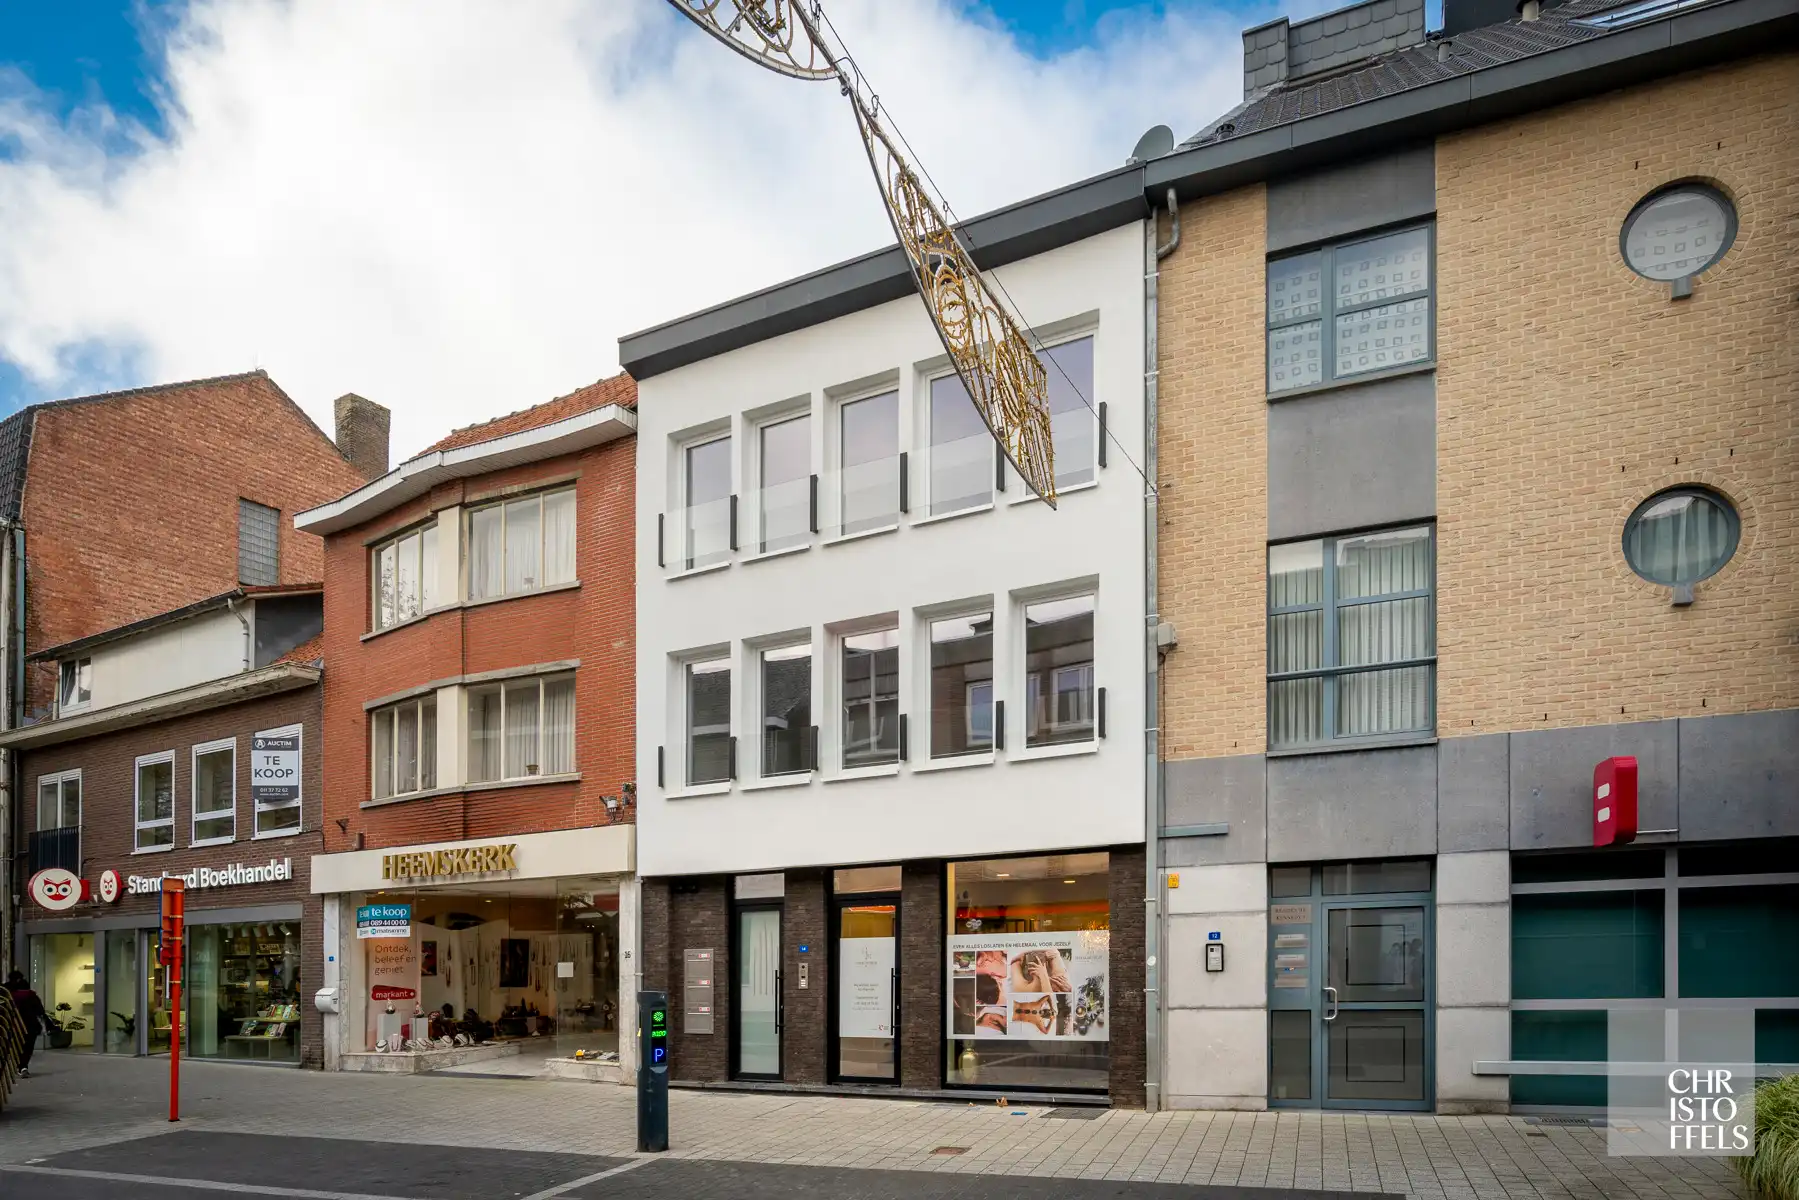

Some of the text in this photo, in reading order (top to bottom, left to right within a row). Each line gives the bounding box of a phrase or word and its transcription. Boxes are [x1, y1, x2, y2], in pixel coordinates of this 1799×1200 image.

[264, 755, 280, 765] TE
[254, 768, 294, 778] KOOP
[382, 844, 517, 880] HEEMSKERK
[200, 858, 292, 887] Boekhandel
[371, 908, 381, 917] te
[383, 907, 407, 917] koop
[374, 945, 412, 954] Ontdek,
[374, 954, 417, 964] beleef en
[374, 966, 404, 975] geniet
[375, 990, 408, 999] markant
[655, 1048, 664, 1062] P
